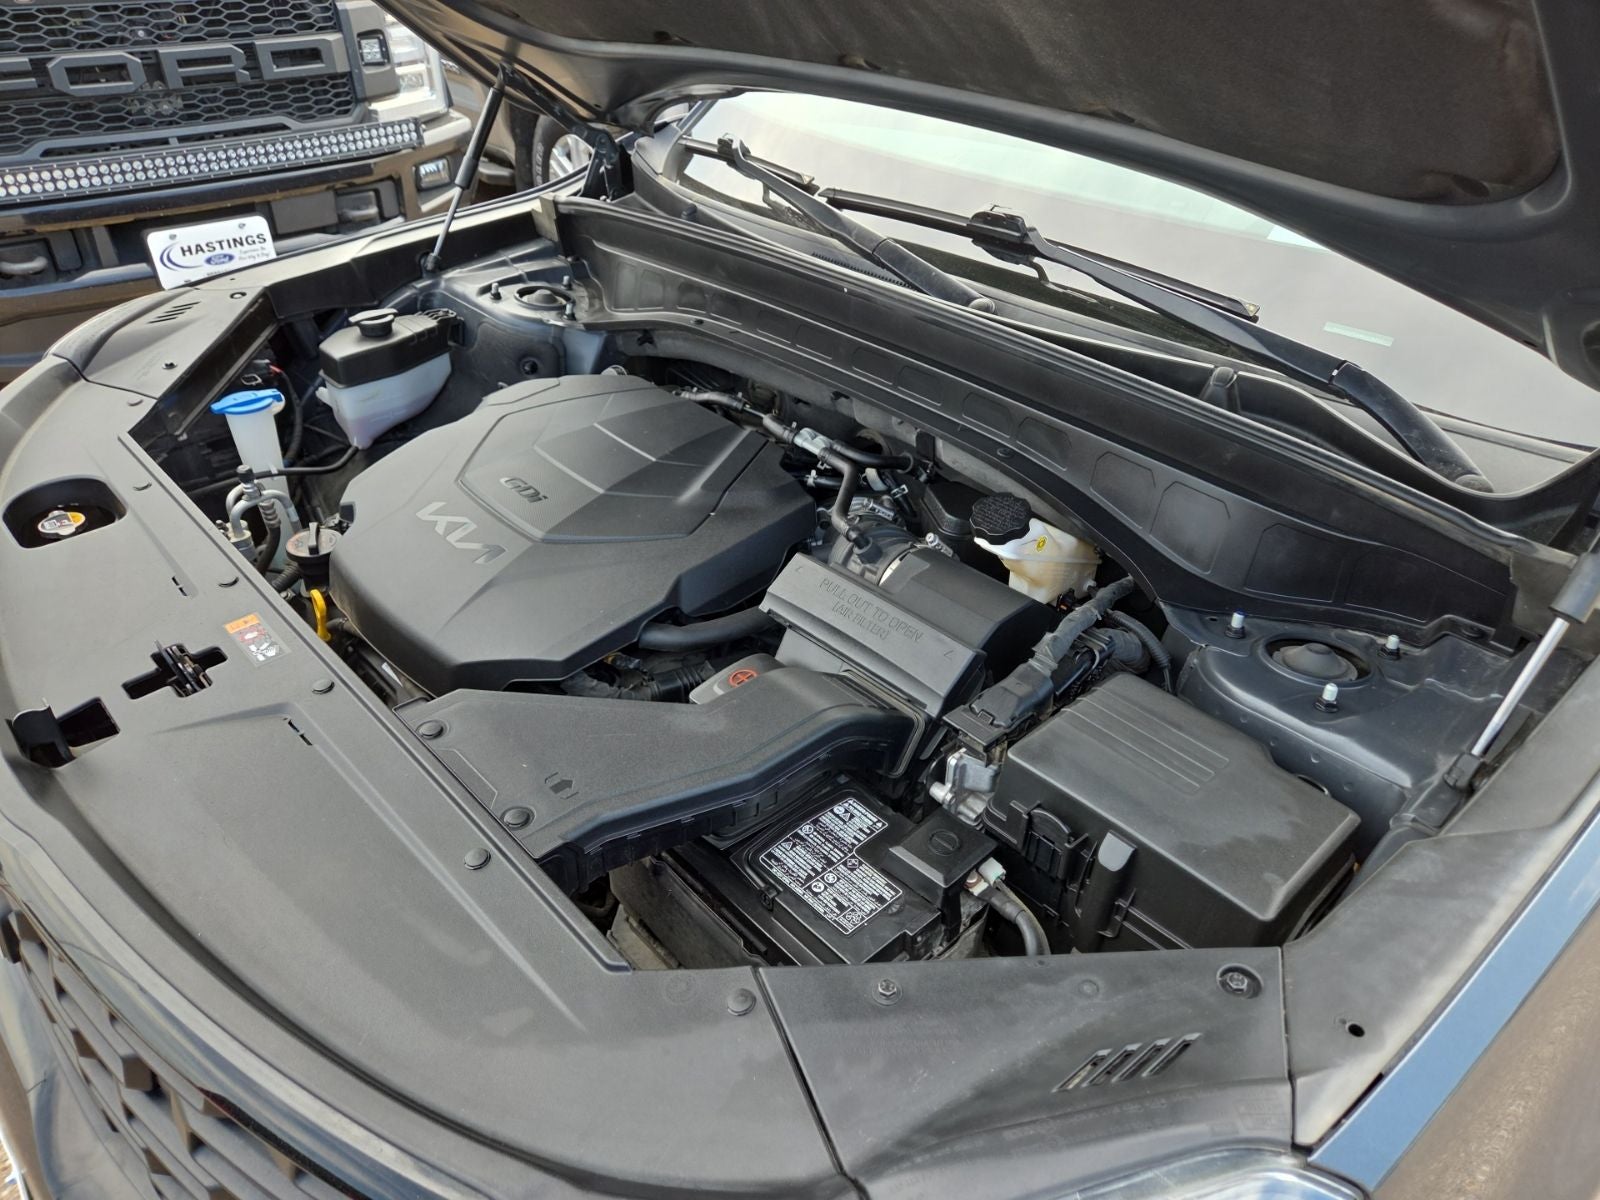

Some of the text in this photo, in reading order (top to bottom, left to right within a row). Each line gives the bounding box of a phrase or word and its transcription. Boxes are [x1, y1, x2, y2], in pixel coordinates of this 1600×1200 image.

[180, 233, 267, 257] HASTINGS
[818, 578, 846, 602] PULL
[847, 593, 873, 614] OUT
[888, 616, 924, 642] OPEN
